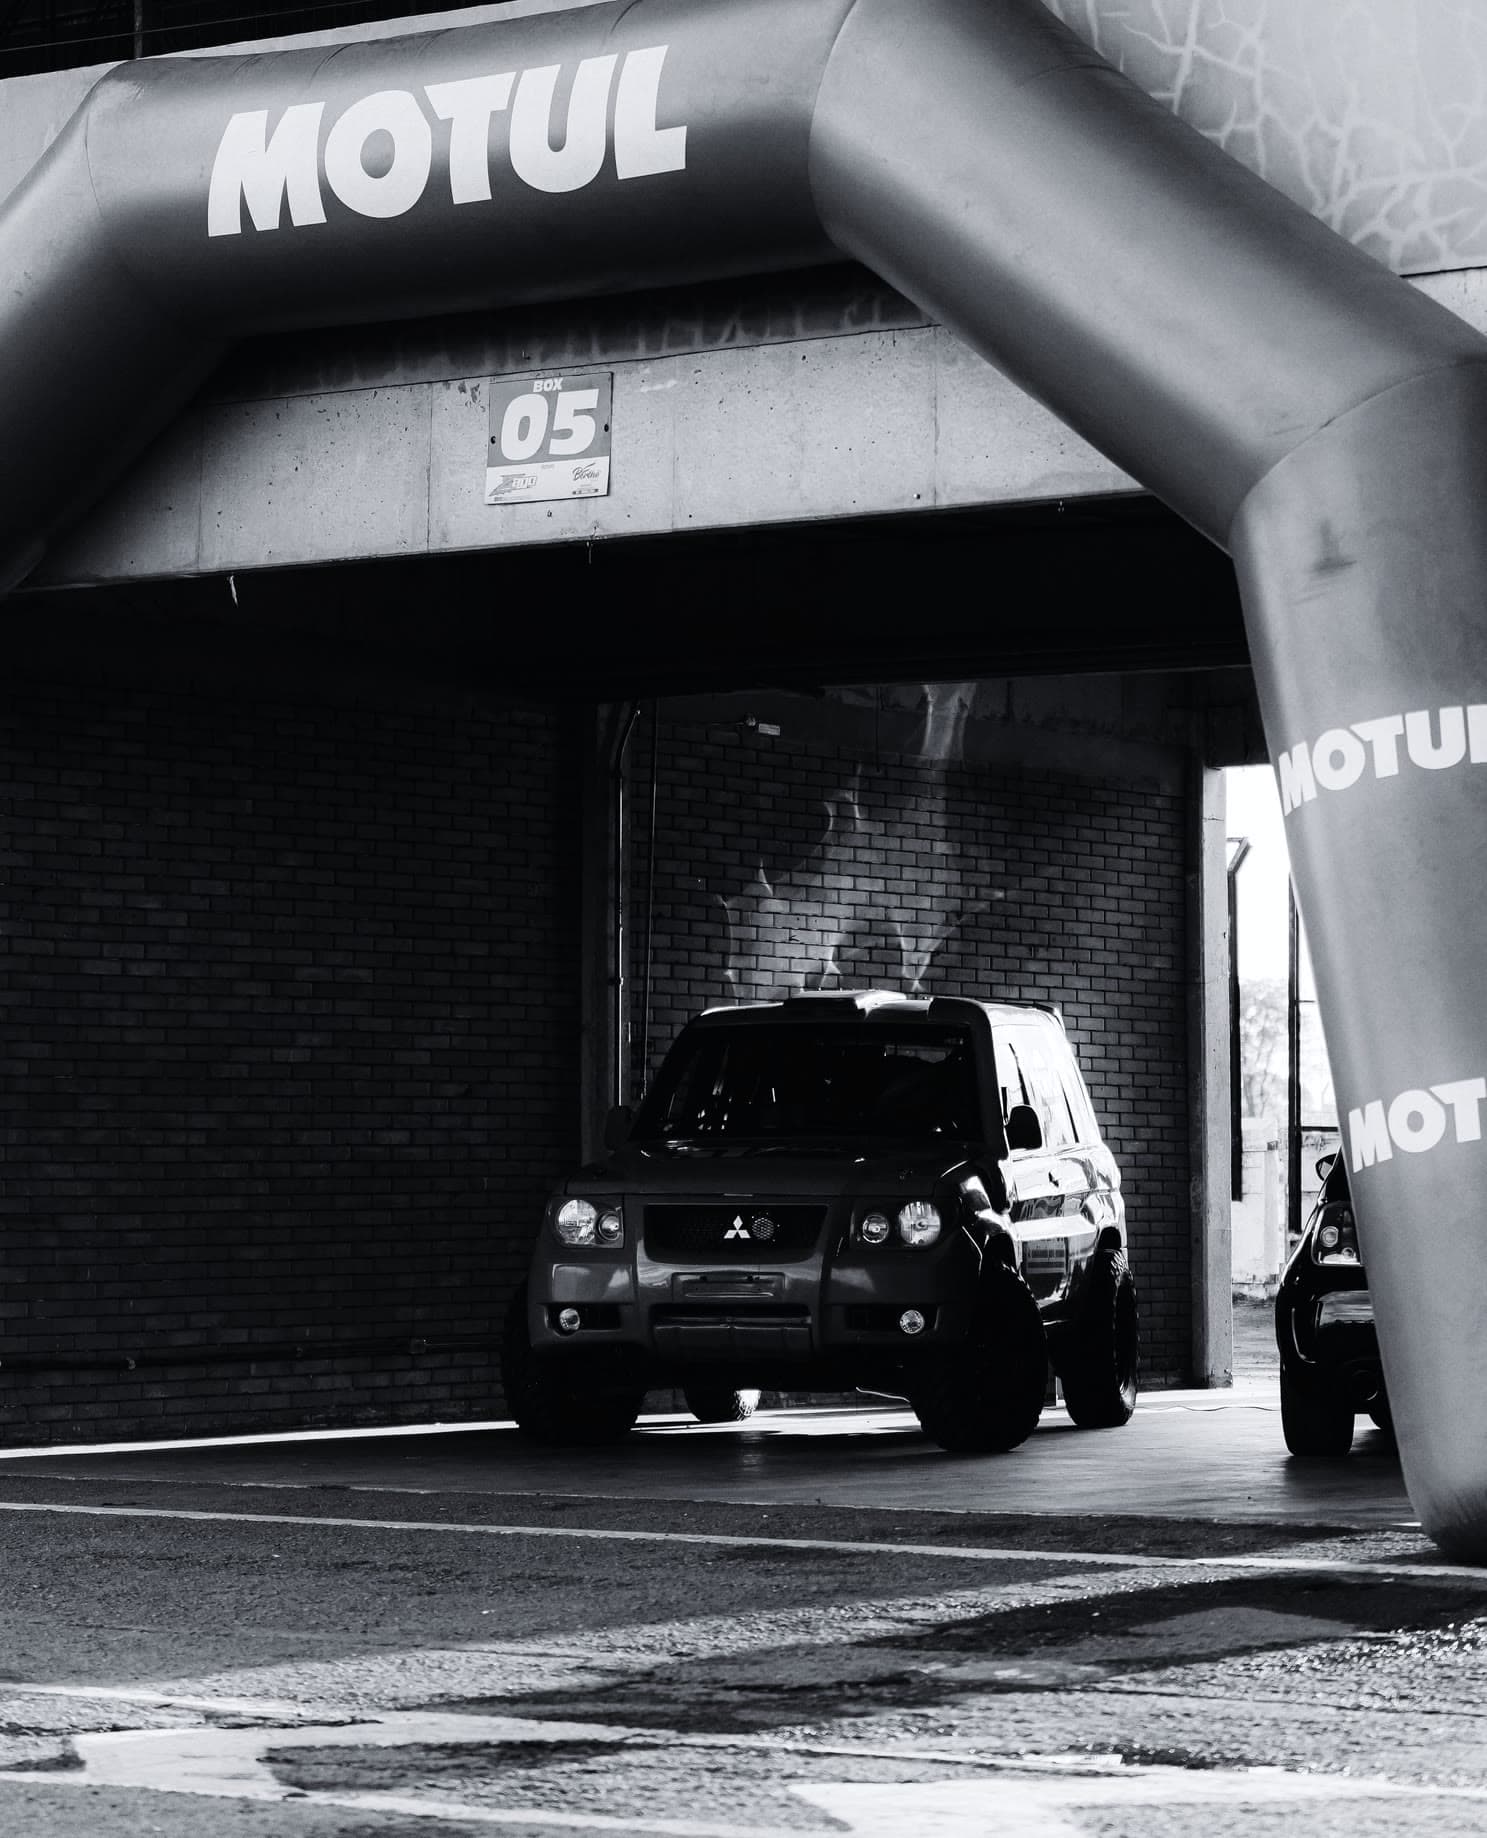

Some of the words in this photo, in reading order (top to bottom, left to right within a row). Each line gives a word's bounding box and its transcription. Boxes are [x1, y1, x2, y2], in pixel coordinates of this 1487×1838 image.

[208, 45, 687, 237] MOTUL
[532, 377, 564, 393] BOX
[501, 388, 599, 460] 05
